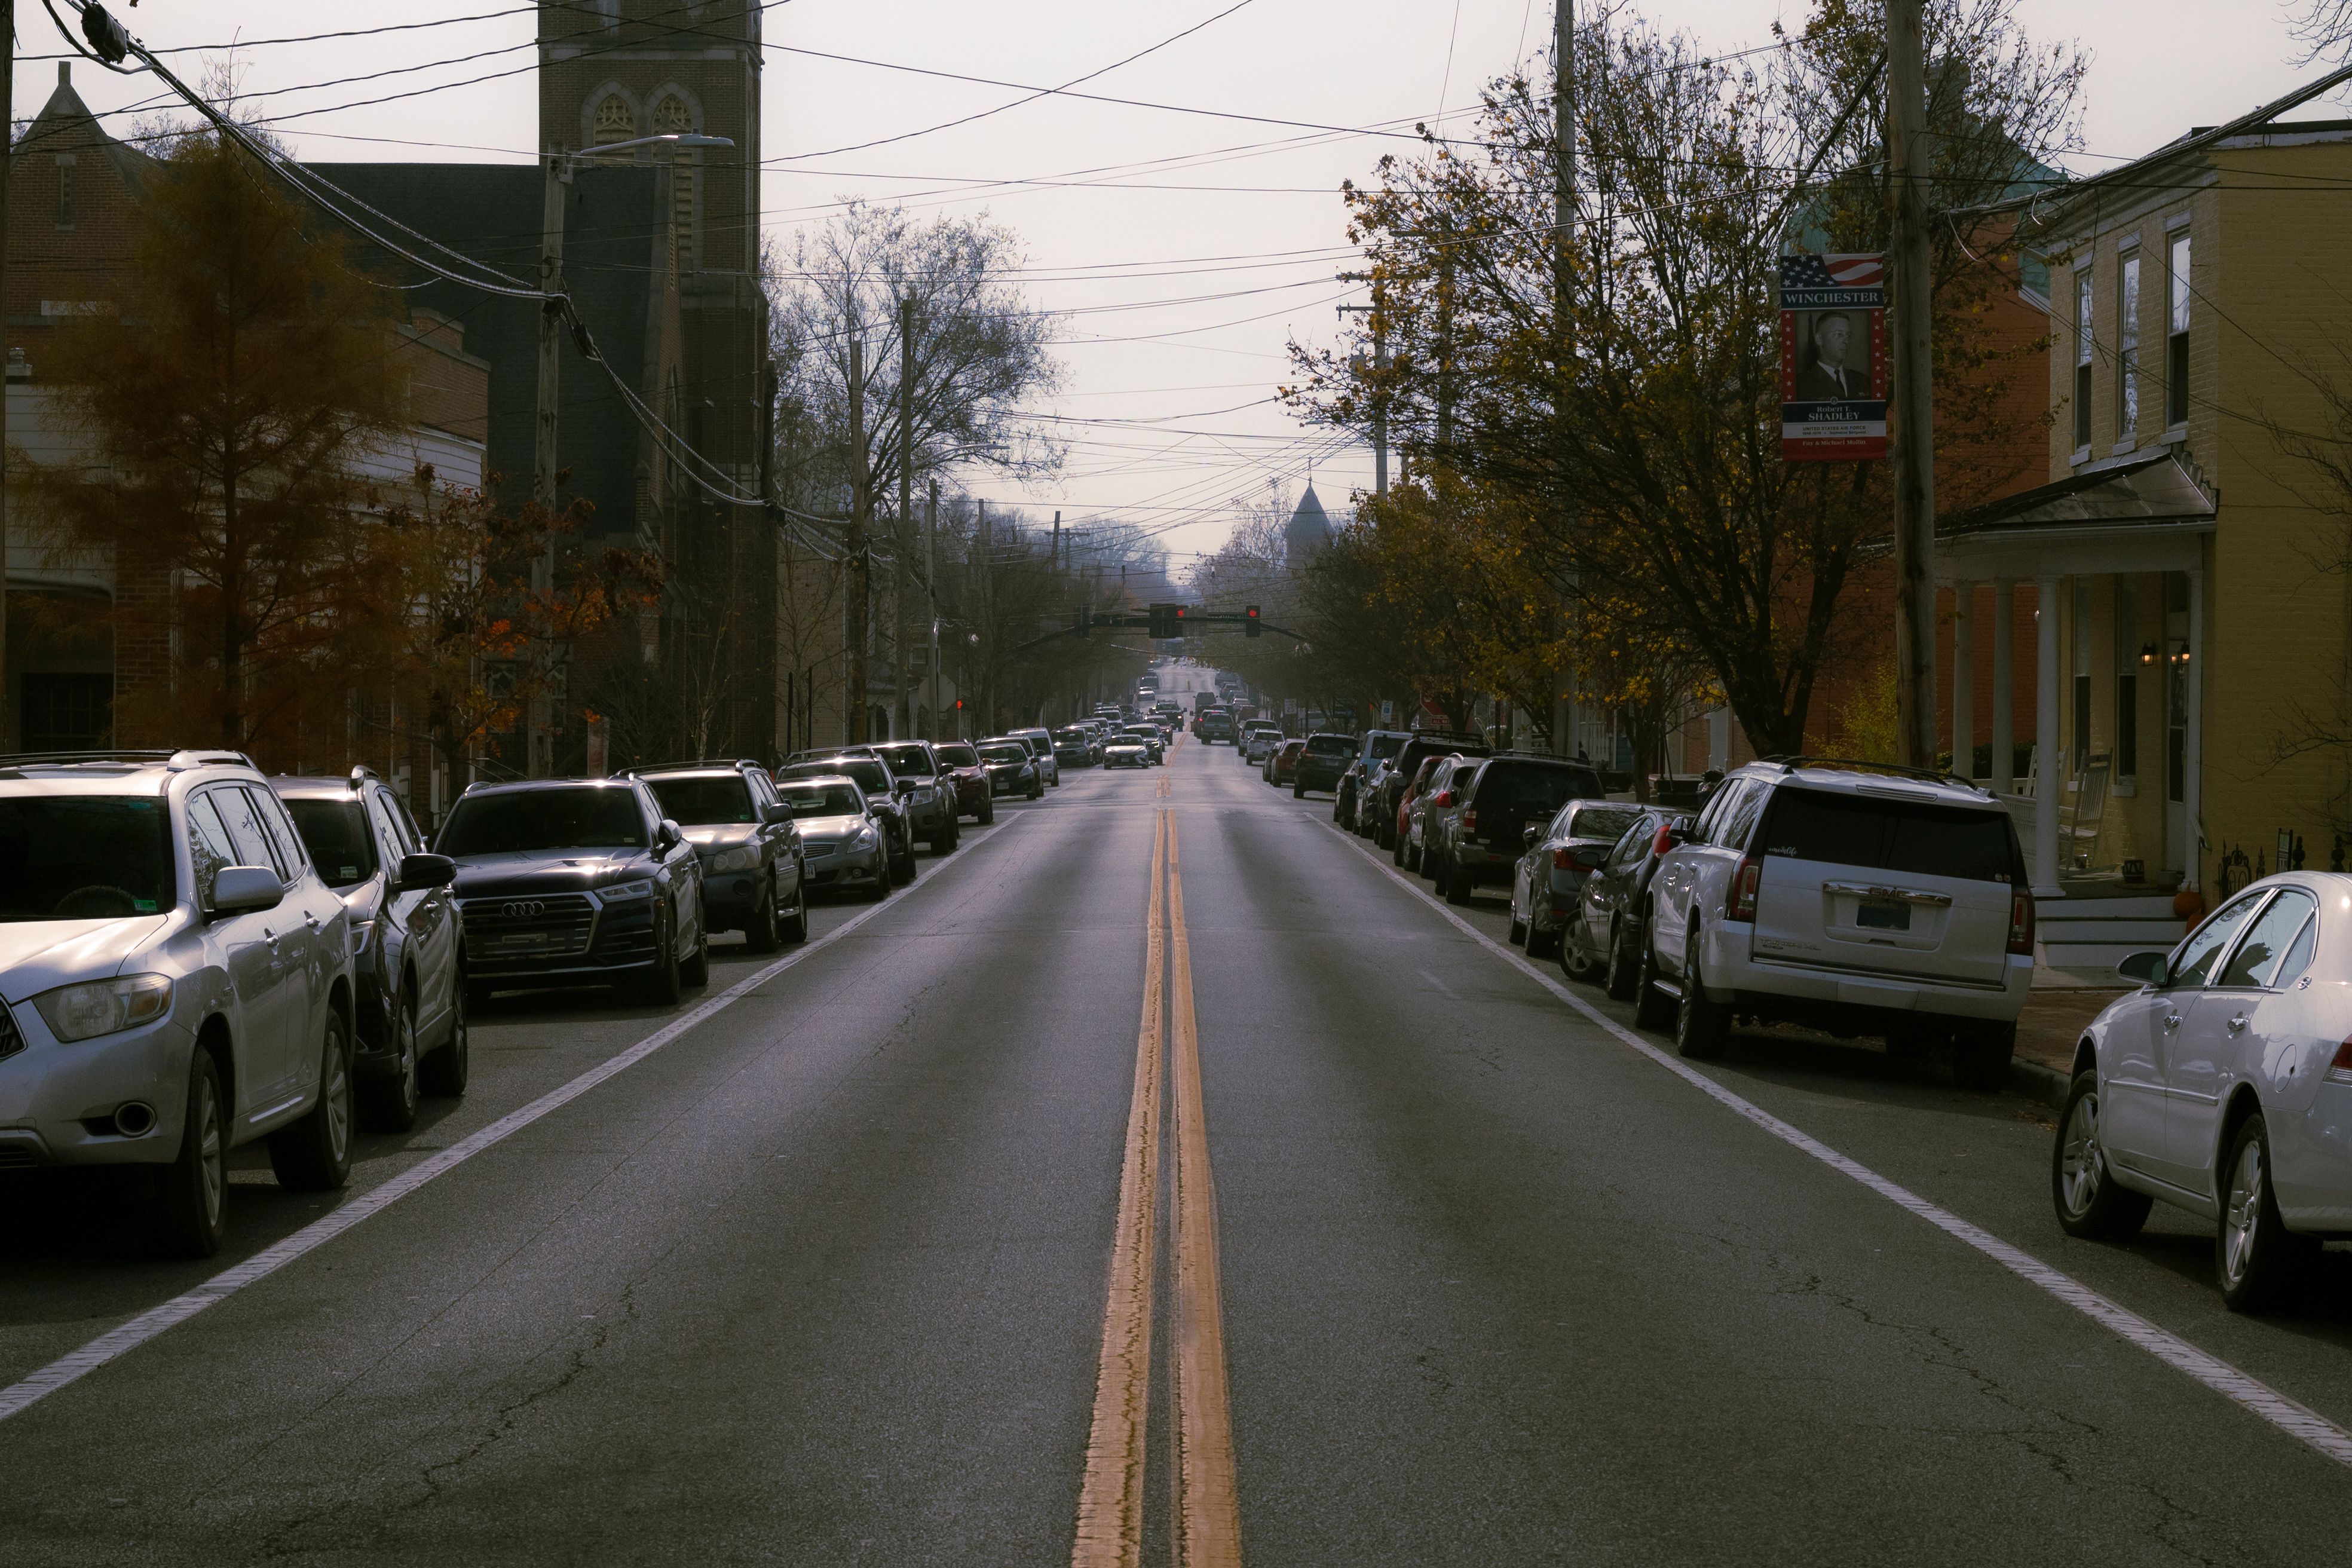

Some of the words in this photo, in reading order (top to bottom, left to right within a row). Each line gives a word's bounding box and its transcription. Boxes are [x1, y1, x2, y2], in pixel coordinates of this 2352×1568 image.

[1786, 292, 1878, 304] WINCHESTER
[1808, 412, 1860, 421] SHADLEY
[1869, 887, 1910, 899] GMC
